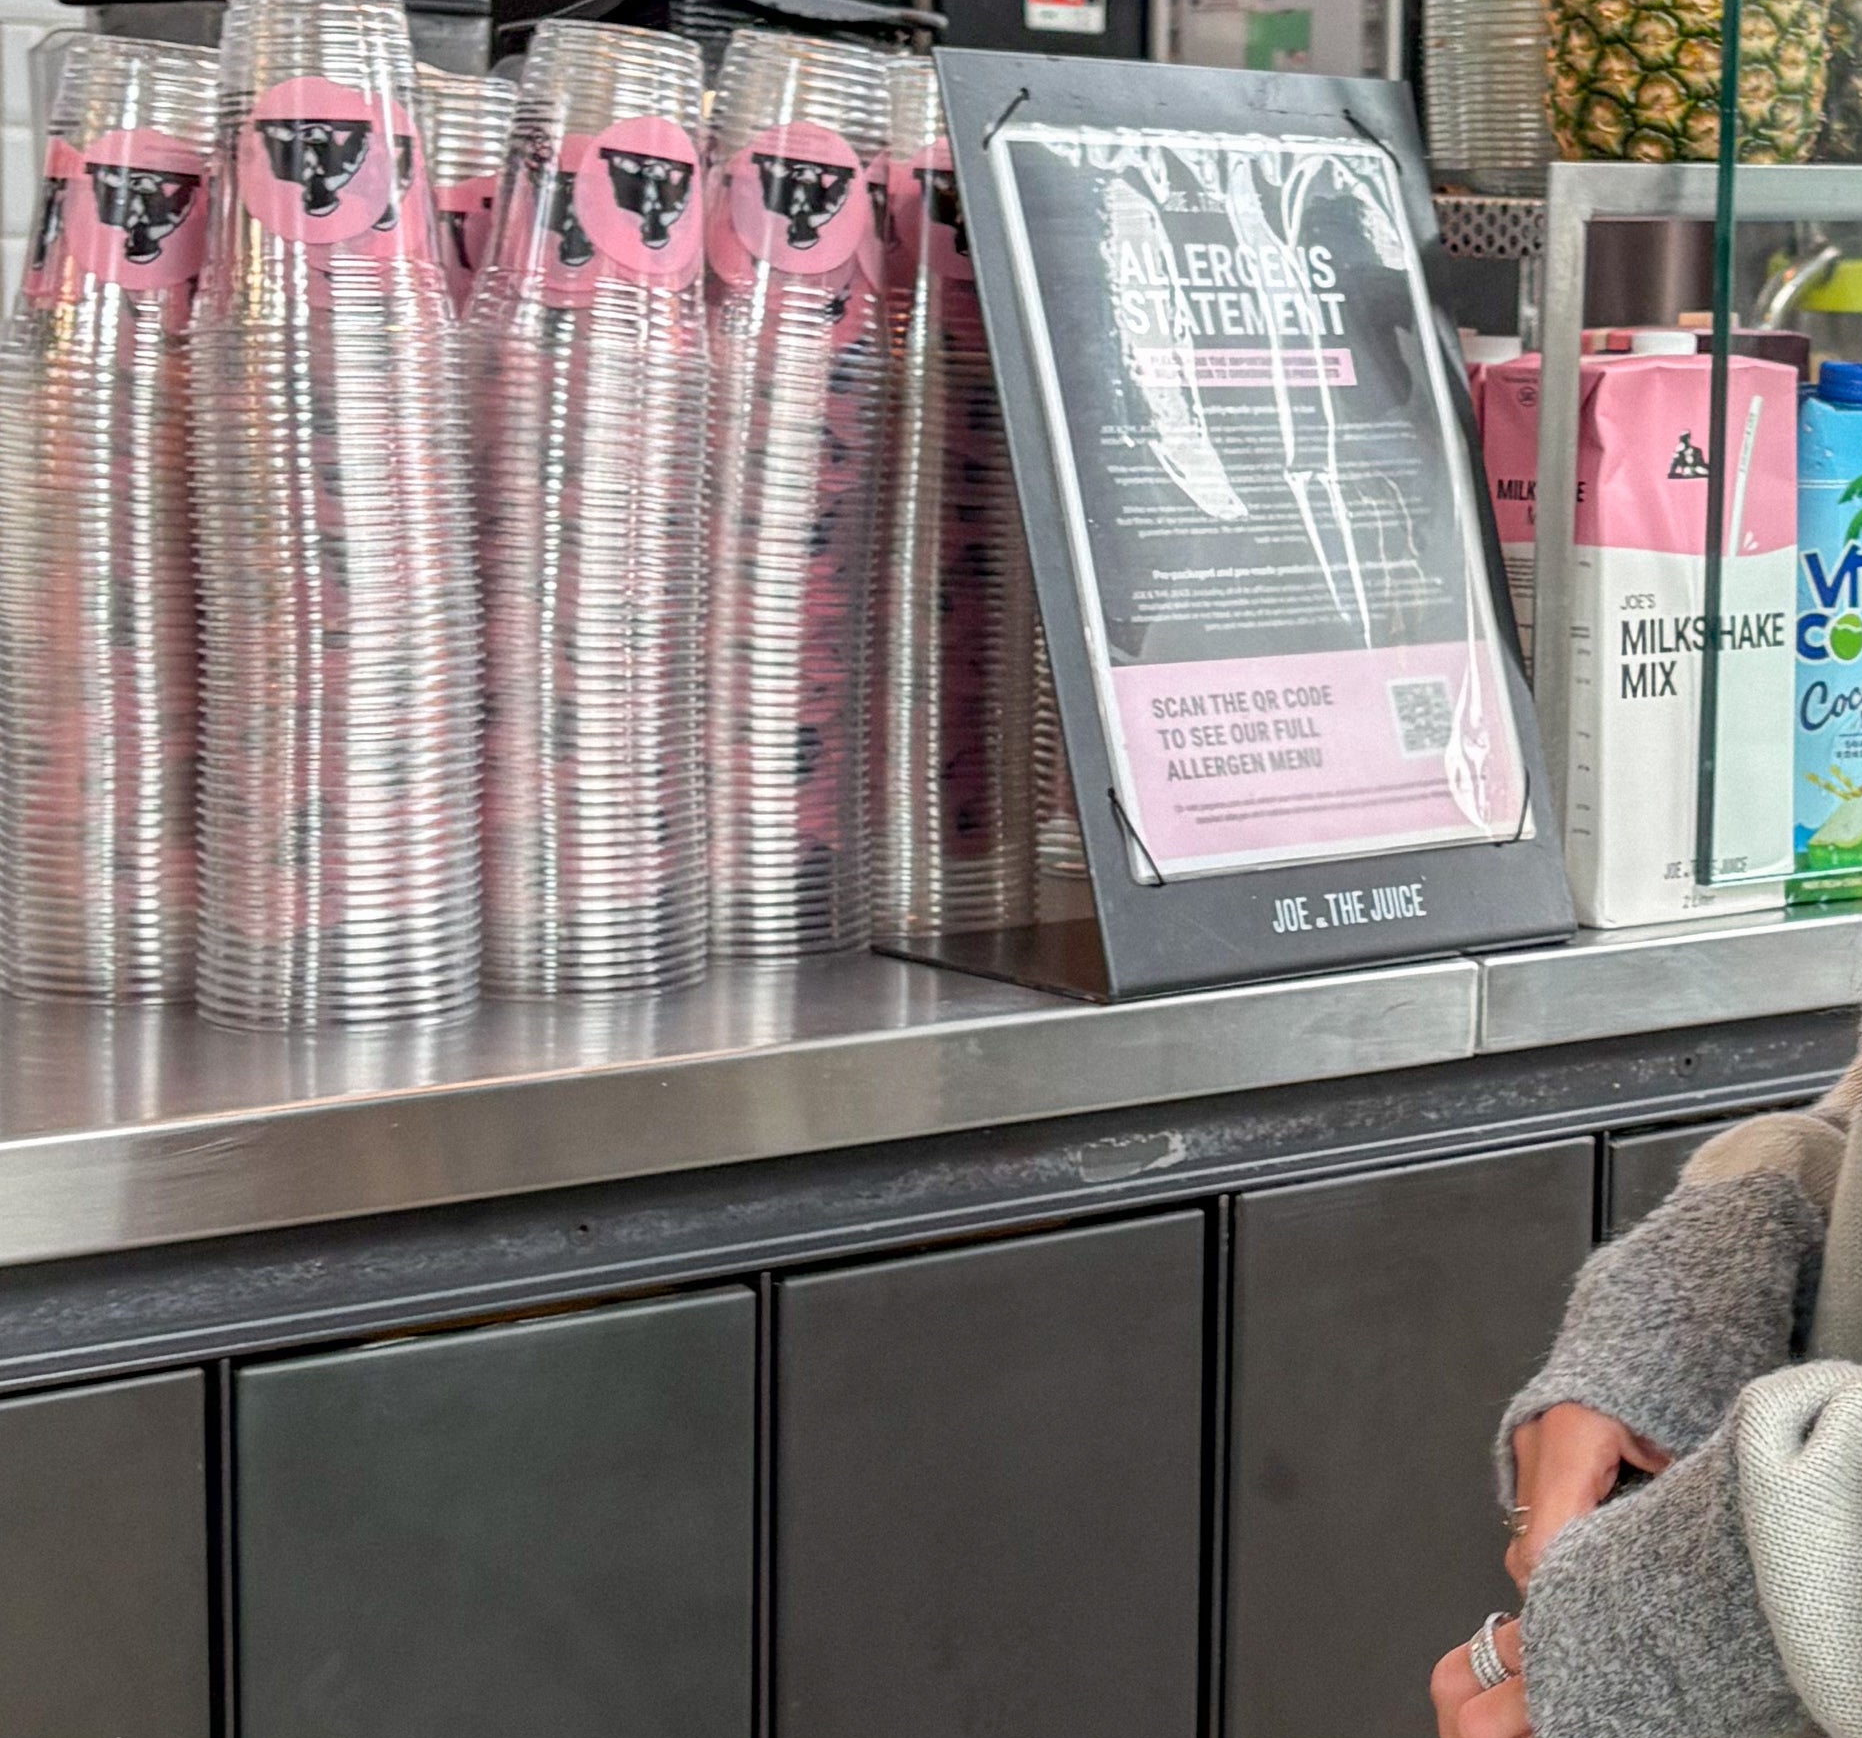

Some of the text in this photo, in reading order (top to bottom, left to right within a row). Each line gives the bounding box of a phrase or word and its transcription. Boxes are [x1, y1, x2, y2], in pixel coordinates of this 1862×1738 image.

[1119, 241, 1336, 288] ALLERGENS
[1122, 291, 1346, 336] STATEMENT
[1620, 594, 1656, 610] JOE'S
[1620, 613, 1785, 656] MILKSHAKE
[1620, 661, 1678, 699] MIX
[1152, 685, 1334, 719] SCAN THE QR CODE
[1158, 717, 1322, 750] TO SEE OUR FULL
[1167, 747, 1324, 782] ALLERGEN MENU
[1272, 897, 1313, 933] JOE
[1323, 890, 1369, 927] THE
[1370, 883, 1427, 922] JUICE
